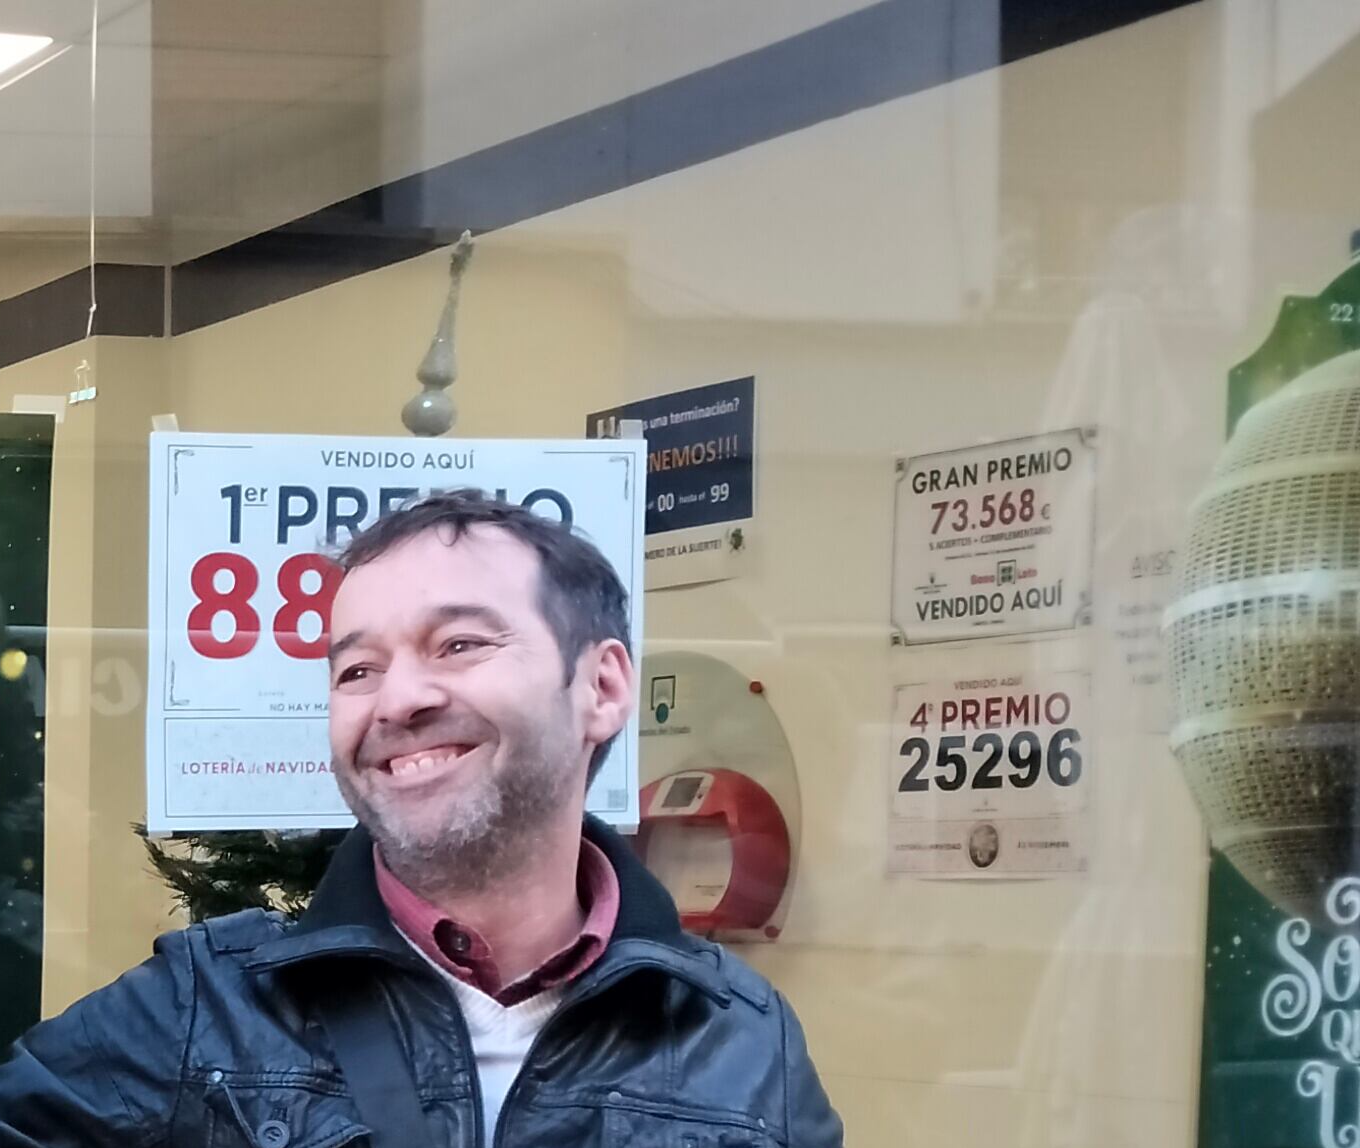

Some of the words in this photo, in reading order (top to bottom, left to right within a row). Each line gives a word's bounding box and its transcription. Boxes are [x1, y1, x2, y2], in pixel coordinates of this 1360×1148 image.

[1330, 303, 1353, 321] 22
[670, 397, 740, 424] terminación?
[321, 450, 415, 468] VENDIDO
[422, 449, 475, 470] AQUÍ
[647, 434, 738, 472] NEMOS!!!
[912, 463, 978, 495] GRAN
[987, 447, 1073, 483] PREMIO
[657, 493, 675, 512] 00
[710, 482, 730, 503] 99
[931, 488, 1036, 535] 73.568
[220, 484, 268, 544] 1er
[678, 544, 687, 555] LA
[916, 592, 1004, 622] VENDIDO
[1011, 579, 1064, 612] AQUÍ
[954, 679, 997, 691] VENDIDO
[270, 703, 285, 713] NO
[288, 703, 309, 712] HAY
[941, 692, 1071, 732] PREMIO
[181, 757, 245, 775] LOTERÍA
[898, 728, 1083, 793] 25296
